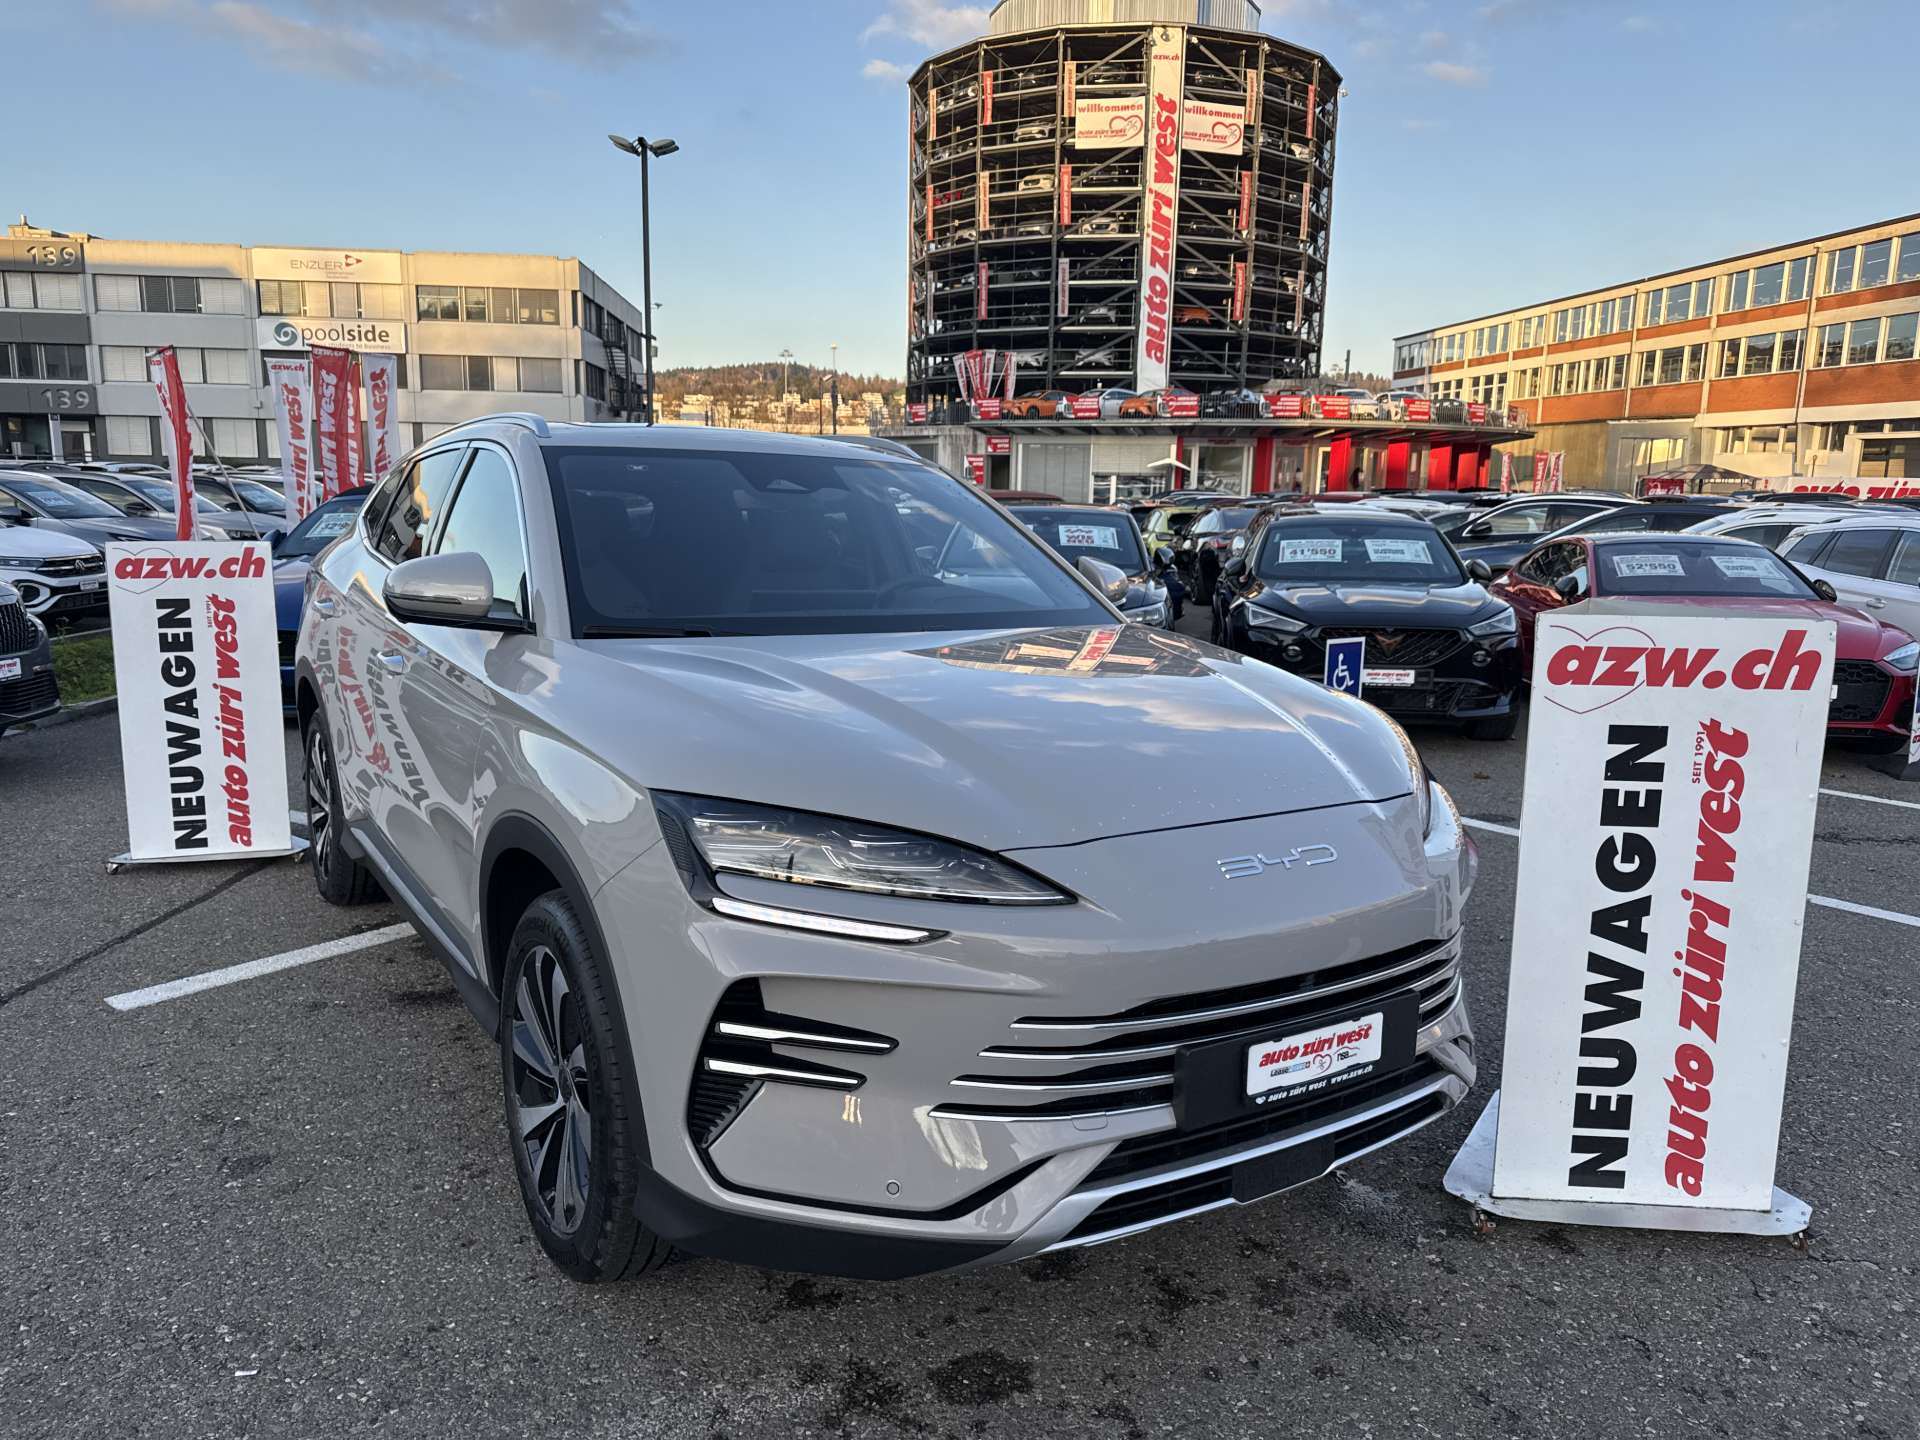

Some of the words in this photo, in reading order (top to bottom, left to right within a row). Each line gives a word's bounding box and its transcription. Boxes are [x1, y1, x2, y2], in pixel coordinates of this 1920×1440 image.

[1077, 102, 1143, 113] willkommen
[1184, 105, 1243, 119] willkommen
[1153, 92, 1179, 184] west
[27, 246, 76, 266] 139
[1146, 186, 1173, 274] züri
[290, 259, 344, 271] ENZLER
[301, 323, 390, 346] poolside
[1144, 274, 1168, 364] auto
[271, 363, 305, 372] azw.ch
[41, 390, 90, 409] 139
[281, 383, 306, 440] west
[320, 369, 337, 432] west
[115, 547, 265, 580] azw.ch
[205, 593, 240, 678] west
[1547, 629, 1822, 691] azw.ch
[155, 598, 209, 850] NEUWAGEN
[213, 683, 247, 763] züri
[1695, 731, 1706, 757] 1991
[1692, 761, 1702, 784] SEIT
[1693, 718, 1749, 882] west
[219, 765, 252, 848] auto
[1217, 844, 1338, 879] BYD
[1567, 724, 1669, 1189] NEUWAGEN
[1679, 888, 1730, 1044] züri
[1259, 1044, 1300, 1068] auto
[1300, 1032, 1337, 1057] züri
[1337, 1024, 1372, 1047] west
[1268, 1091, 1287, 1102] auto
[1308, 1079, 1327, 1091] west
[1664, 1043, 1713, 1196] auto
